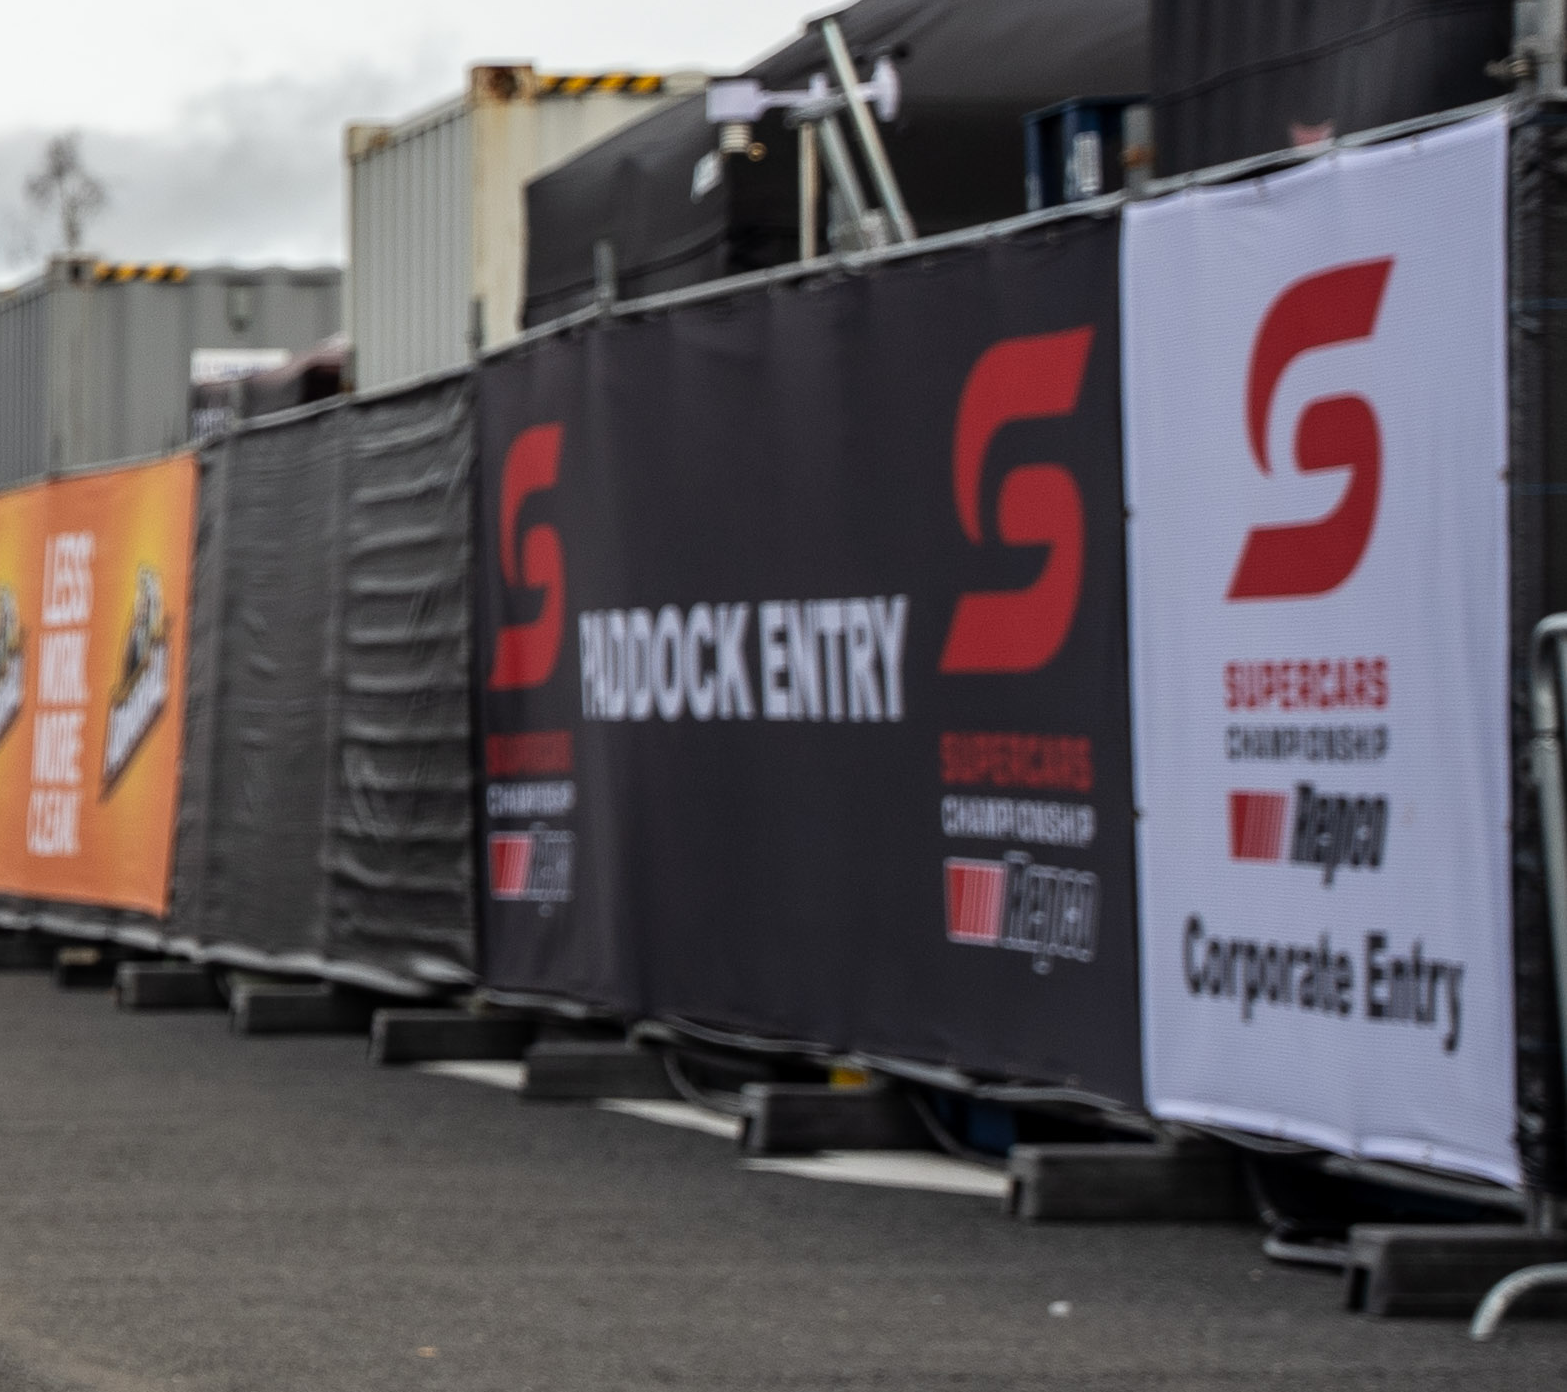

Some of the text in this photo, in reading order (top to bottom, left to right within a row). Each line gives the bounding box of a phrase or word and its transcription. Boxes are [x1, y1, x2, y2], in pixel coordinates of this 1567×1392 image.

[41, 530, 96, 626] LESS
[758, 594, 909, 722] ENTRY
[1224, 655, 1390, 712] SUPERCARS
[939, 731, 1093, 791] SUPERCARS
[1224, 723, 1390, 763] CHAMPIONSHIP
[940, 795, 1095, 849] CHAMPIONSHIP
[1290, 781, 1390, 888] Repco
[1183, 912, 1467, 1056] Corporate Entry
